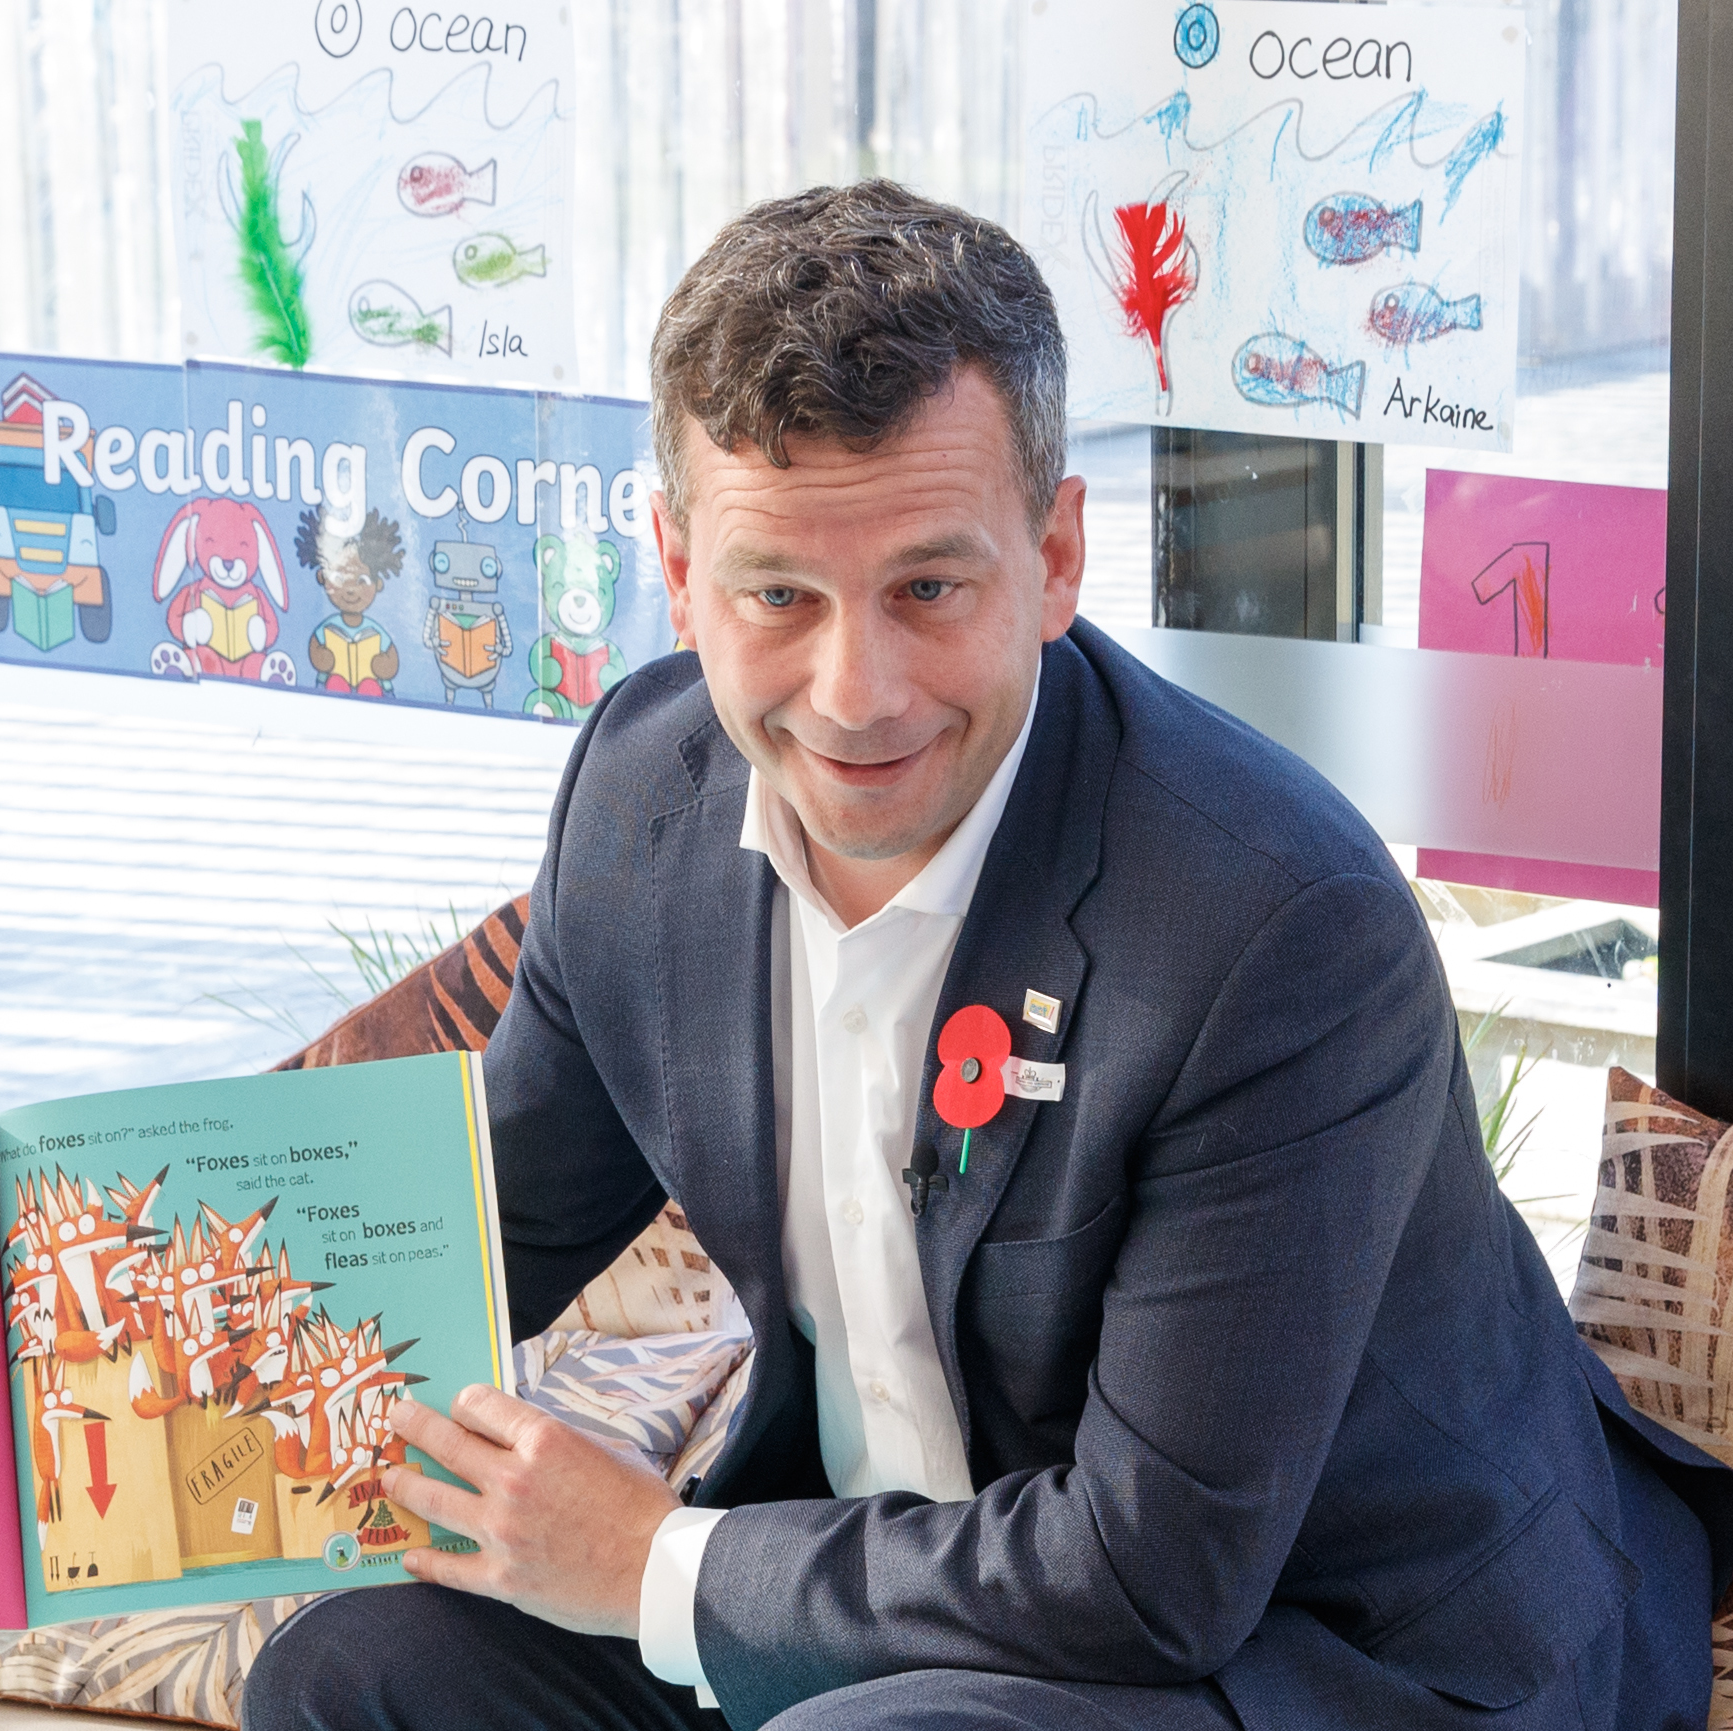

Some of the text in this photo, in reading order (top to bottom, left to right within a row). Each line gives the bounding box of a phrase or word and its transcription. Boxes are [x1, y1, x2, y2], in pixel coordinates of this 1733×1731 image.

[479, 319, 528, 358] Isla
[1383, 378, 1494, 432] Arkaine
[41, 398, 654, 540] Reading Corne
[22, 1143, 38, 1157] do
[37, 1132, 86, 1154] foxes
[87, 1132, 104, 1147] sit
[138, 1121, 177, 1140] asked
[179, 1120, 201, 1135] the
[203, 1117, 235, 1133] frog.
[253, 1154, 269, 1168] sit
[270, 1153, 288, 1166] on
[236, 1172, 315, 1192] said the cat.
[322, 1216, 445, 1244] sit on boxes and
[324, 1252, 369, 1271] fleas
[372, 1251, 387, 1266] sit
[389, 1250, 407, 1264] on
[190, 1433, 256, 1499] FRAGILE
